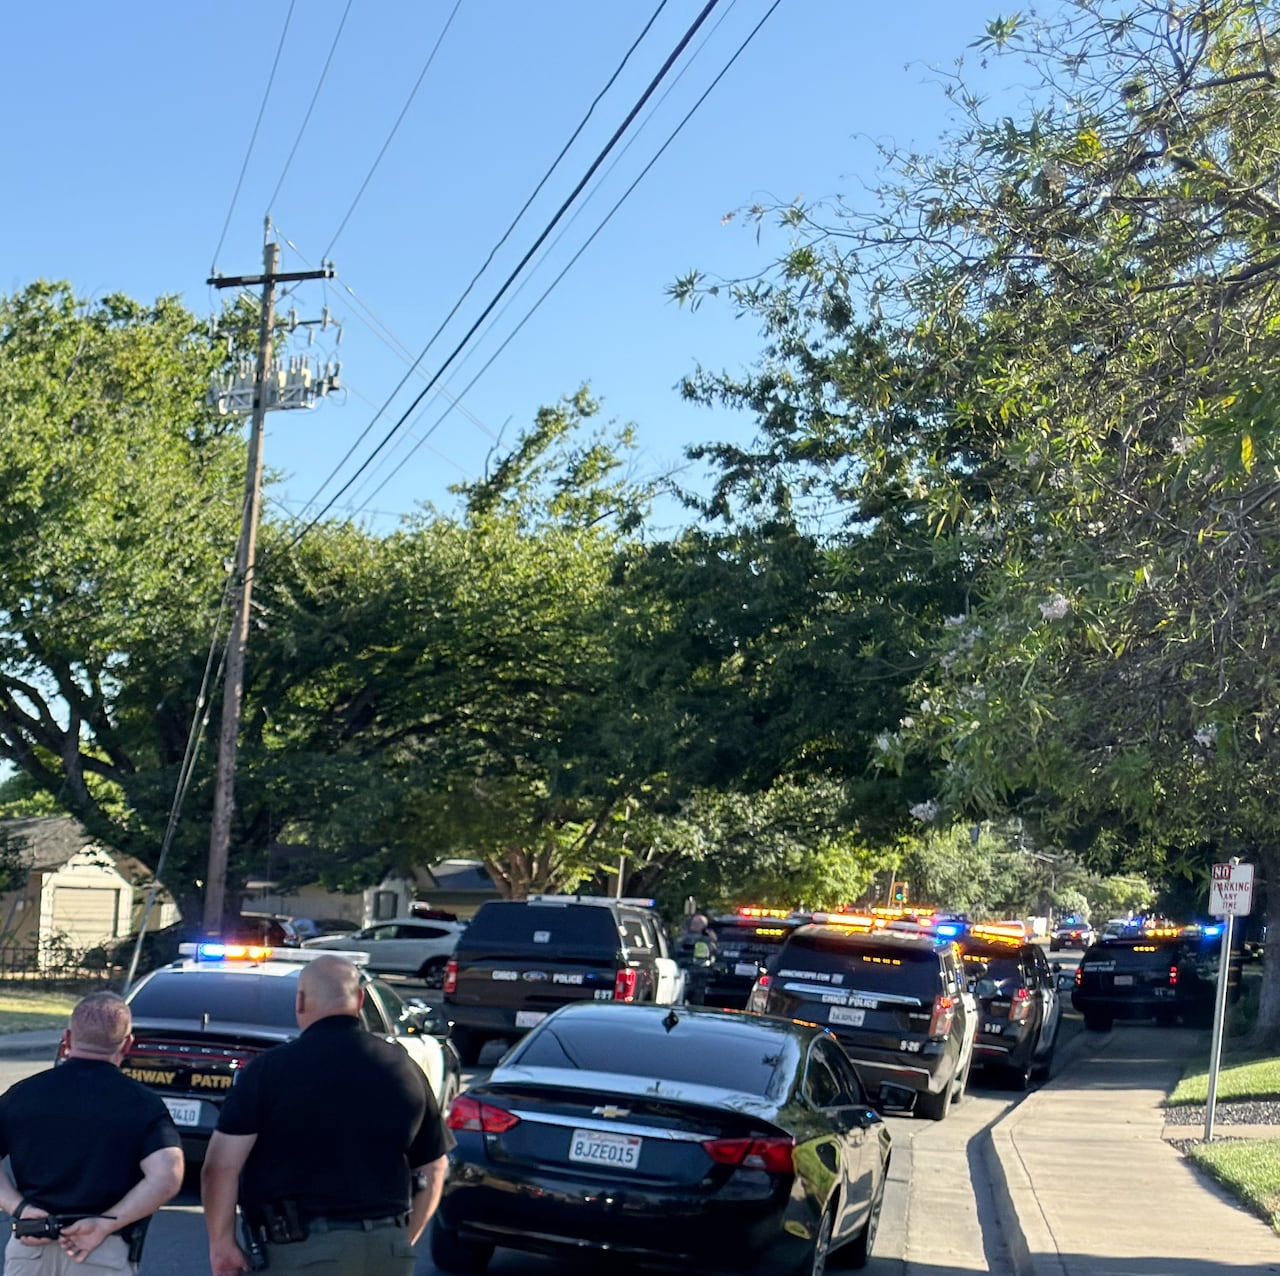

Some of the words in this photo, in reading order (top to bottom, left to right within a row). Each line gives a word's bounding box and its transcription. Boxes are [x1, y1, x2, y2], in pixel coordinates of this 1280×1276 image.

[1214, 865, 1230, 879] NO
[1213, 881, 1250, 892] PARKING
[1223, 901, 1237, 909] TIME
[492, 970, 518, 980] CHICO
[552, 973, 583, 984] POLICE
[822, 994, 846, 1005] CHICO
[848, 995, 878, 1009] POLICE
[191, 1073, 233, 1089] PATR
[574, 1141, 634, 1163] 8JZE015
